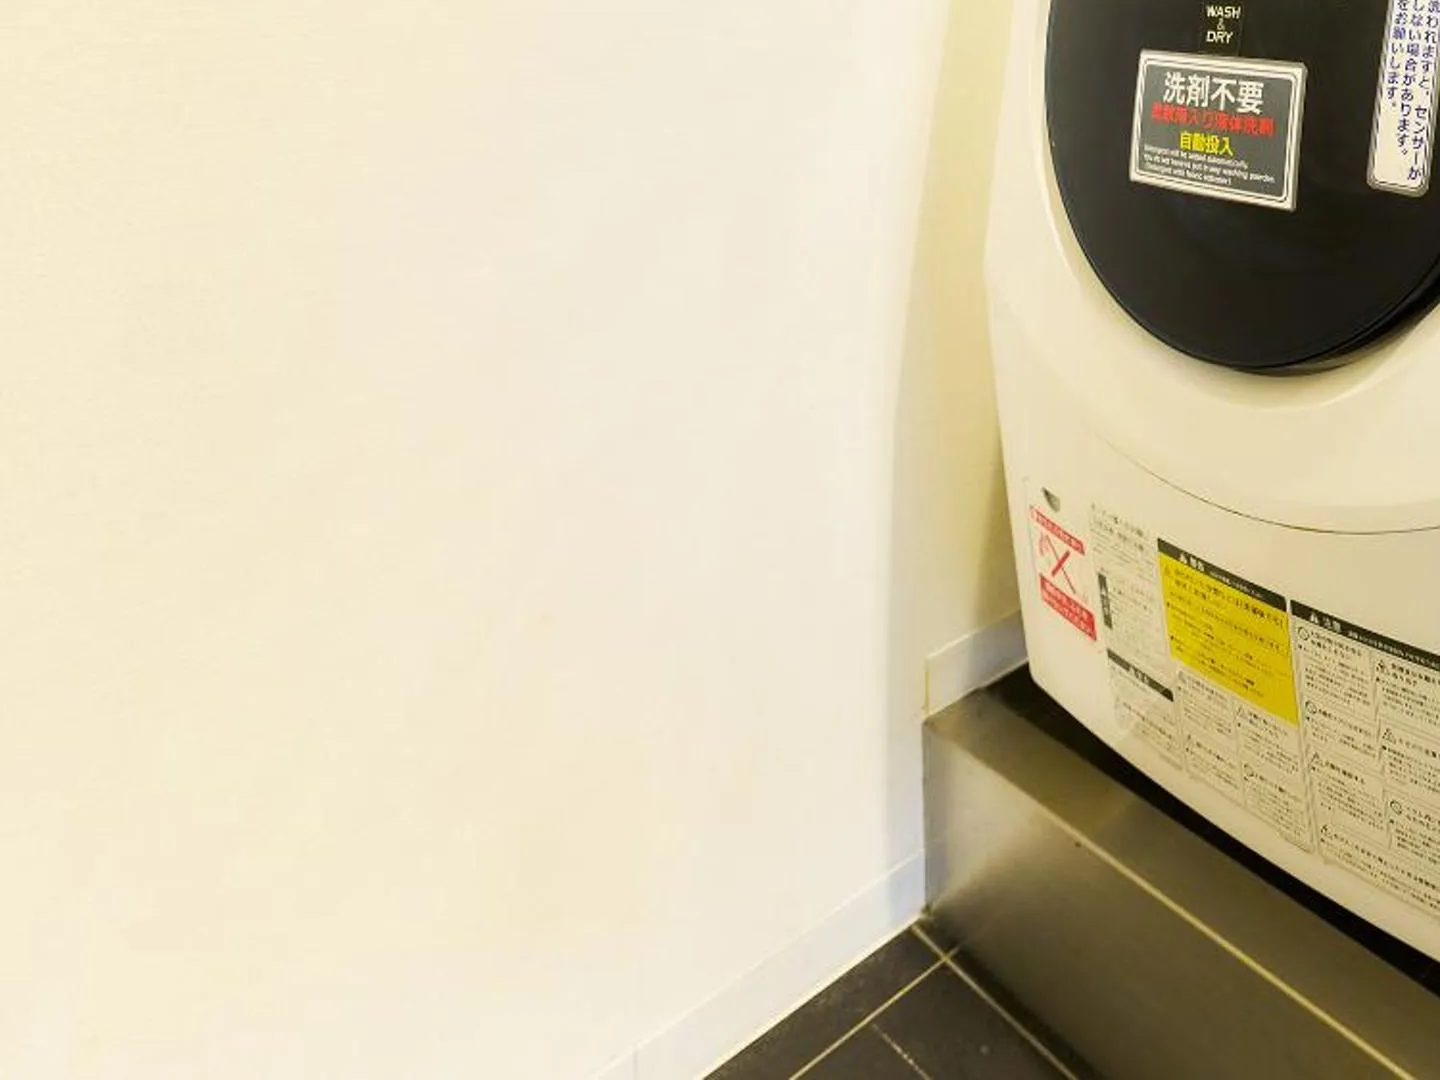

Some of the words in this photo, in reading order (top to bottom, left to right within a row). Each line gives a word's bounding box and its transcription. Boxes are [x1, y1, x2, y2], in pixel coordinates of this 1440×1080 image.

[1206, 5, 1242, 19] WASH
[1216, 18, 1226, 31] &
[1206, 30, 1233, 44] DRY
[1163, 71, 1265, 115] 洗剤不要
[1179, 130, 1234, 157] 自動投入
